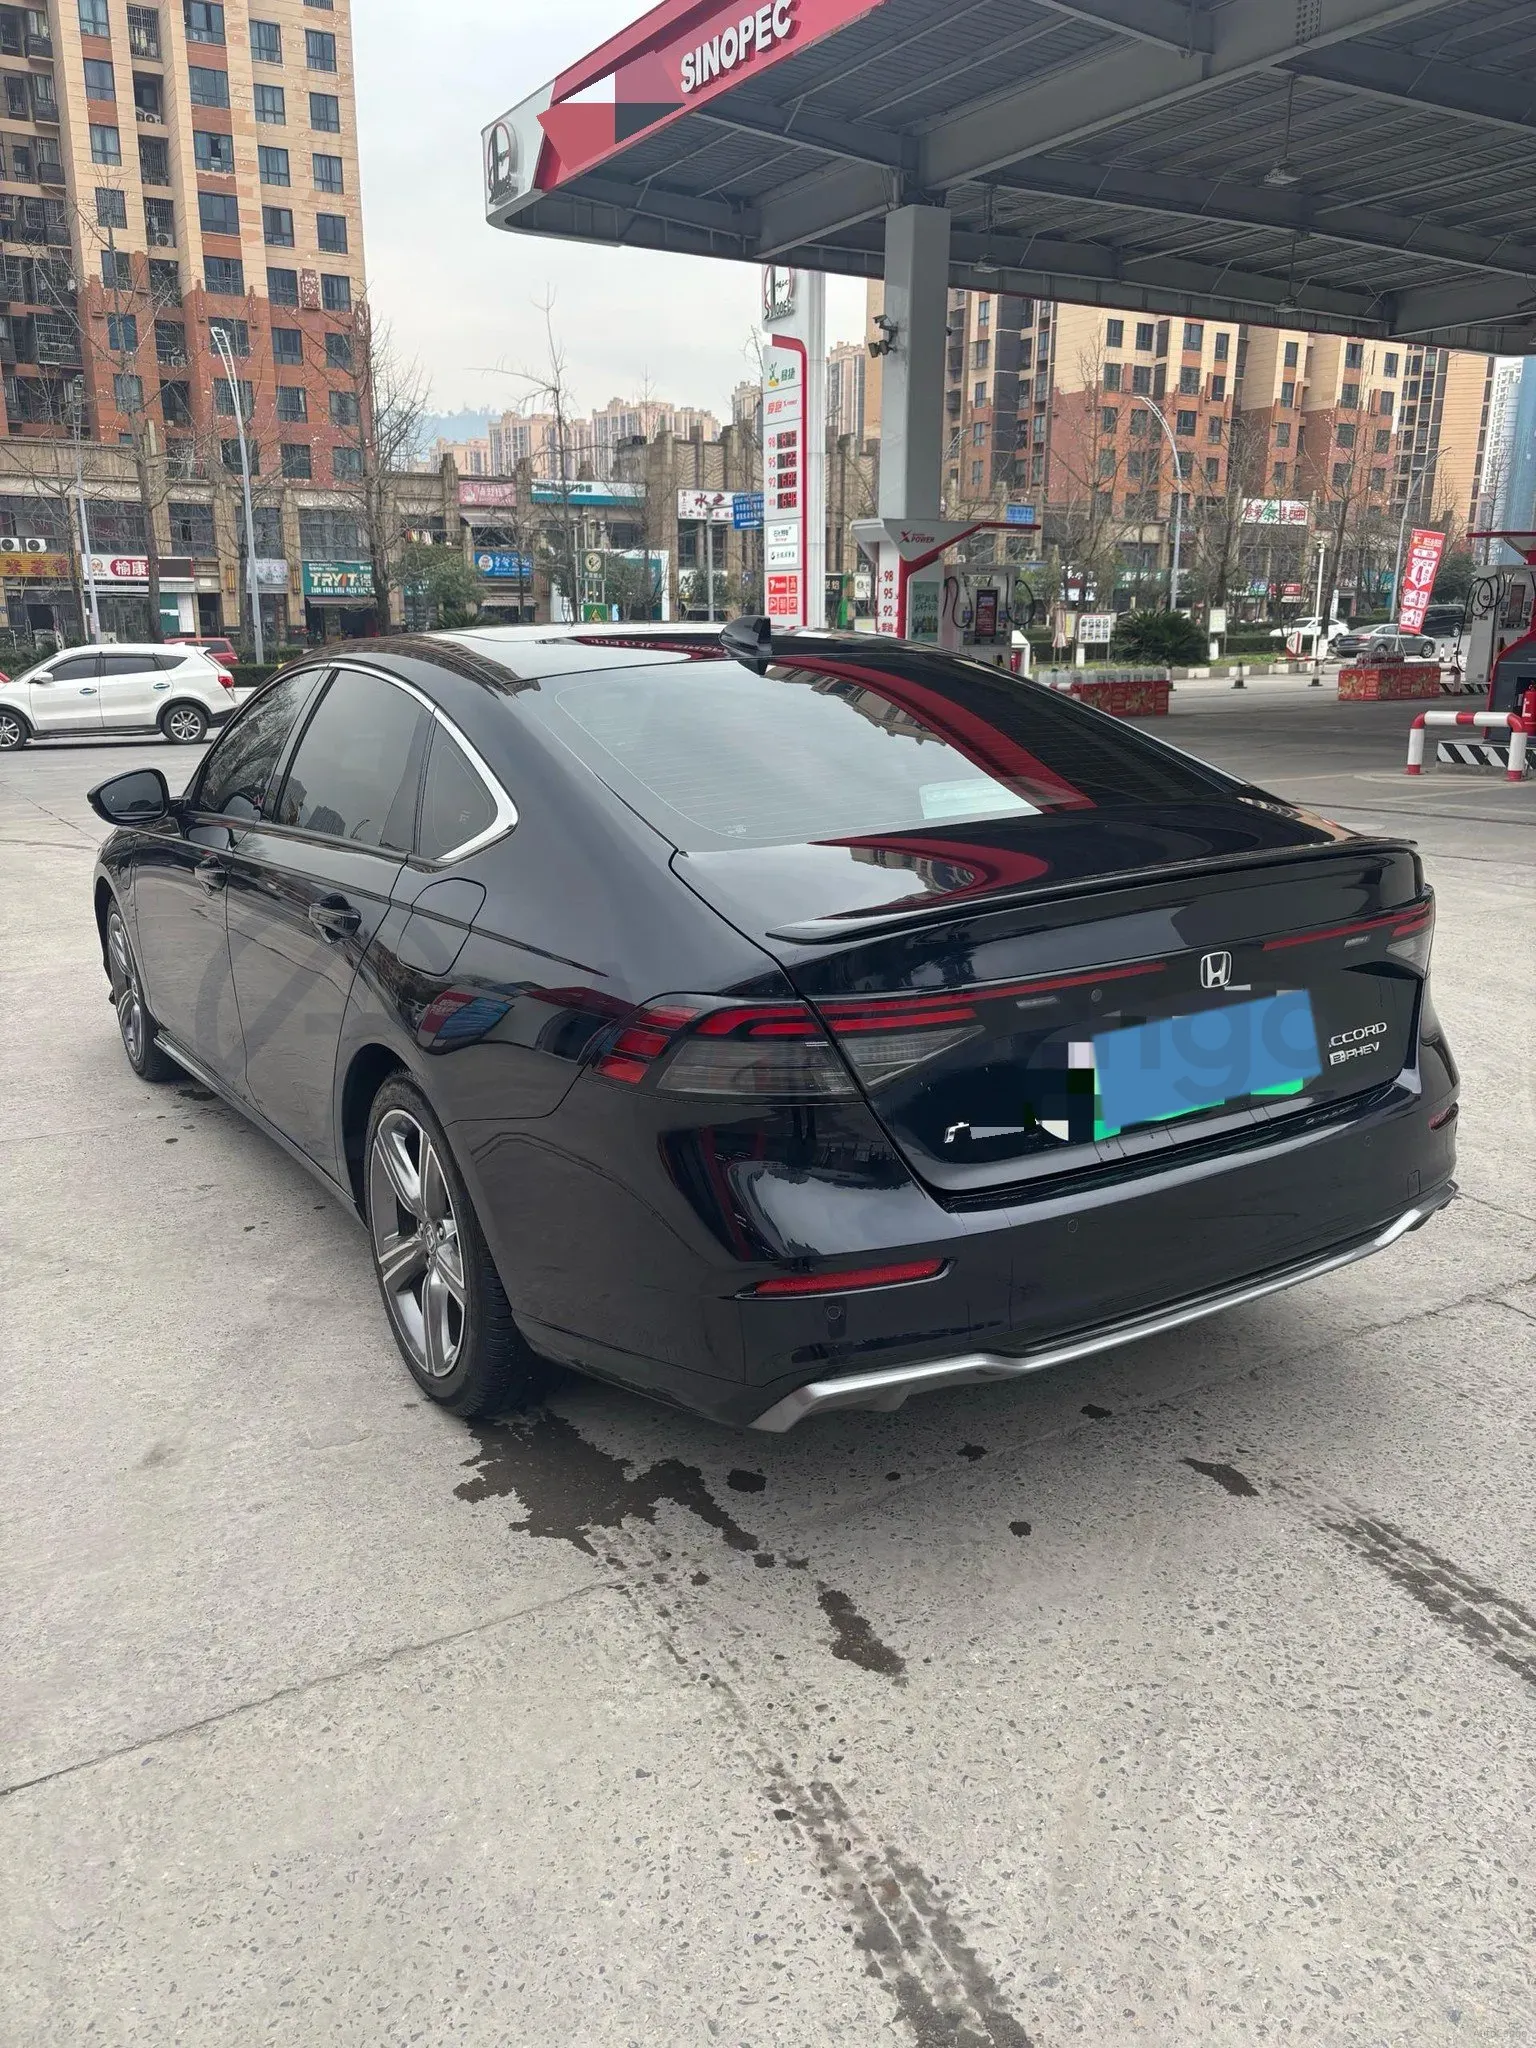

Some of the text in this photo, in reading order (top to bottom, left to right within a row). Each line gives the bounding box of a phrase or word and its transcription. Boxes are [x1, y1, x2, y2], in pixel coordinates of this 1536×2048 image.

[680, 0, 792, 93] SINOPEC
[884, 570, 895, 582] 98
[883, 588, 893, 600] 95
[883, 605, 893, 617] 92
[1329, 1022, 1388, 1048] CCORD
